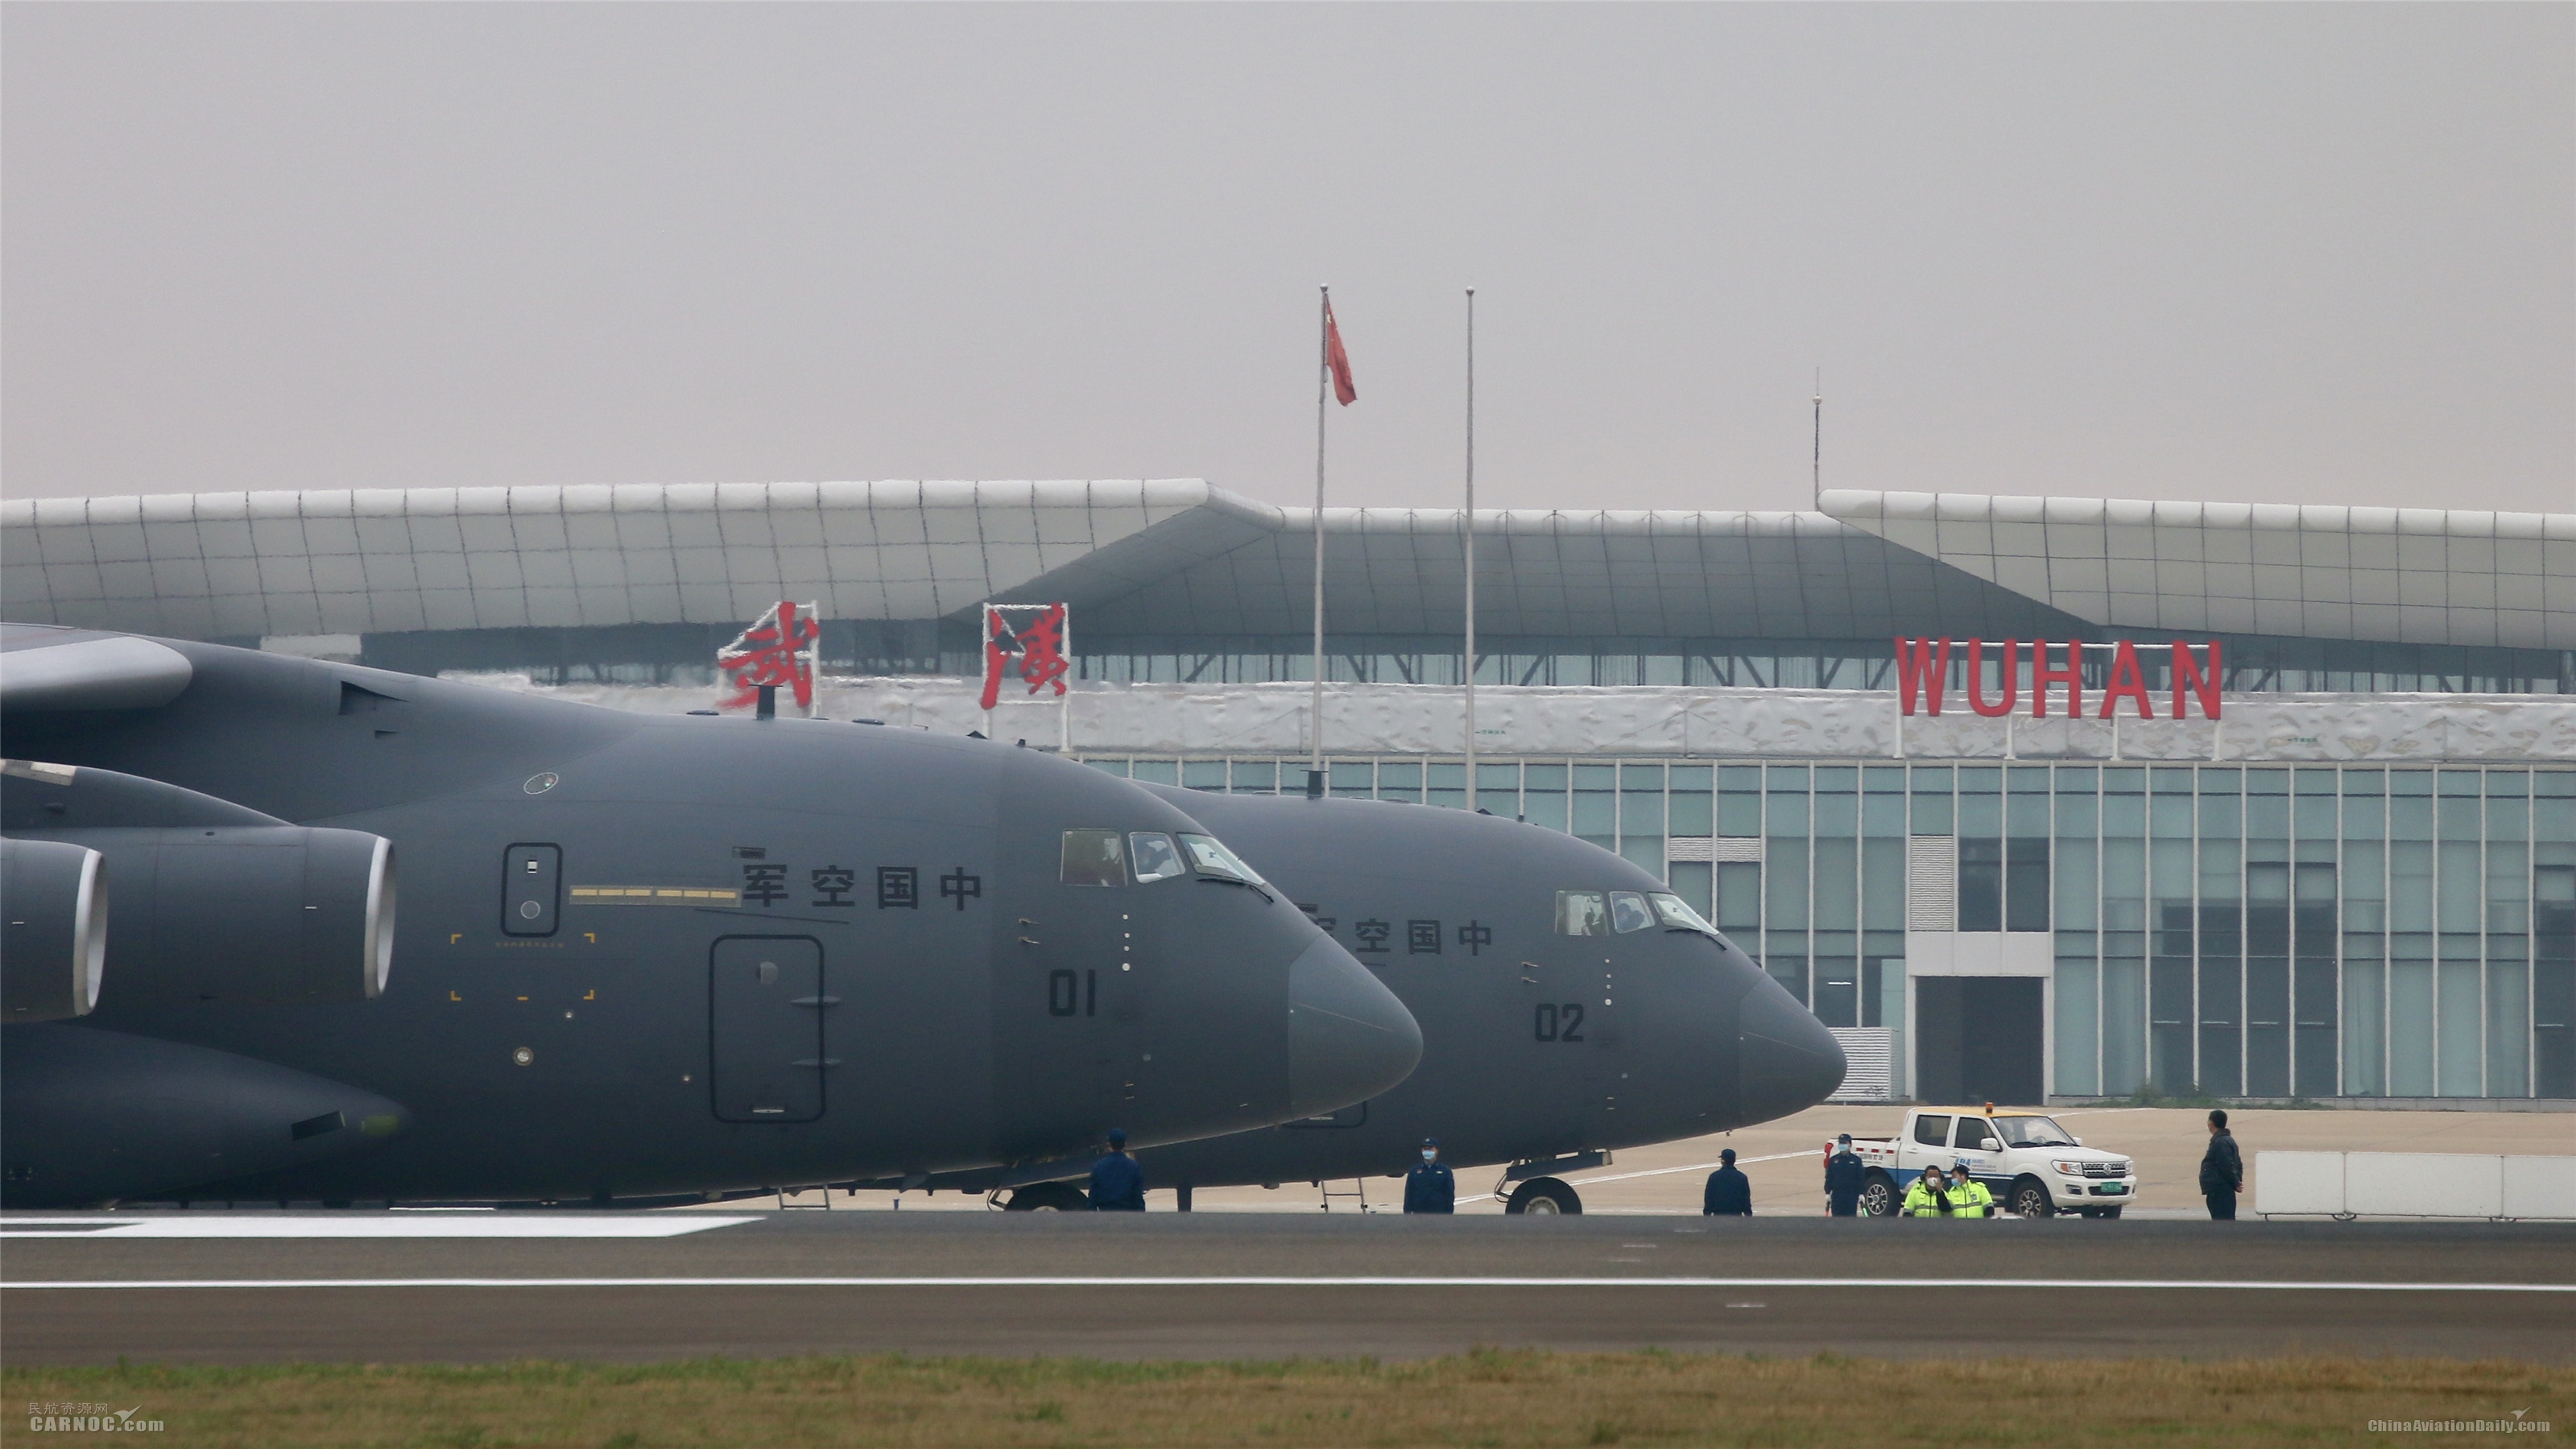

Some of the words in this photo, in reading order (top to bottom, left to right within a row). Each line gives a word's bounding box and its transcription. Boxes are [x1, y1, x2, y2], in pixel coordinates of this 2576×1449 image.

[1895, 637, 2222, 720] WUHAN
[1049, 969, 1096, 1017] 01
[1535, 1003, 1584, 1042] 02
